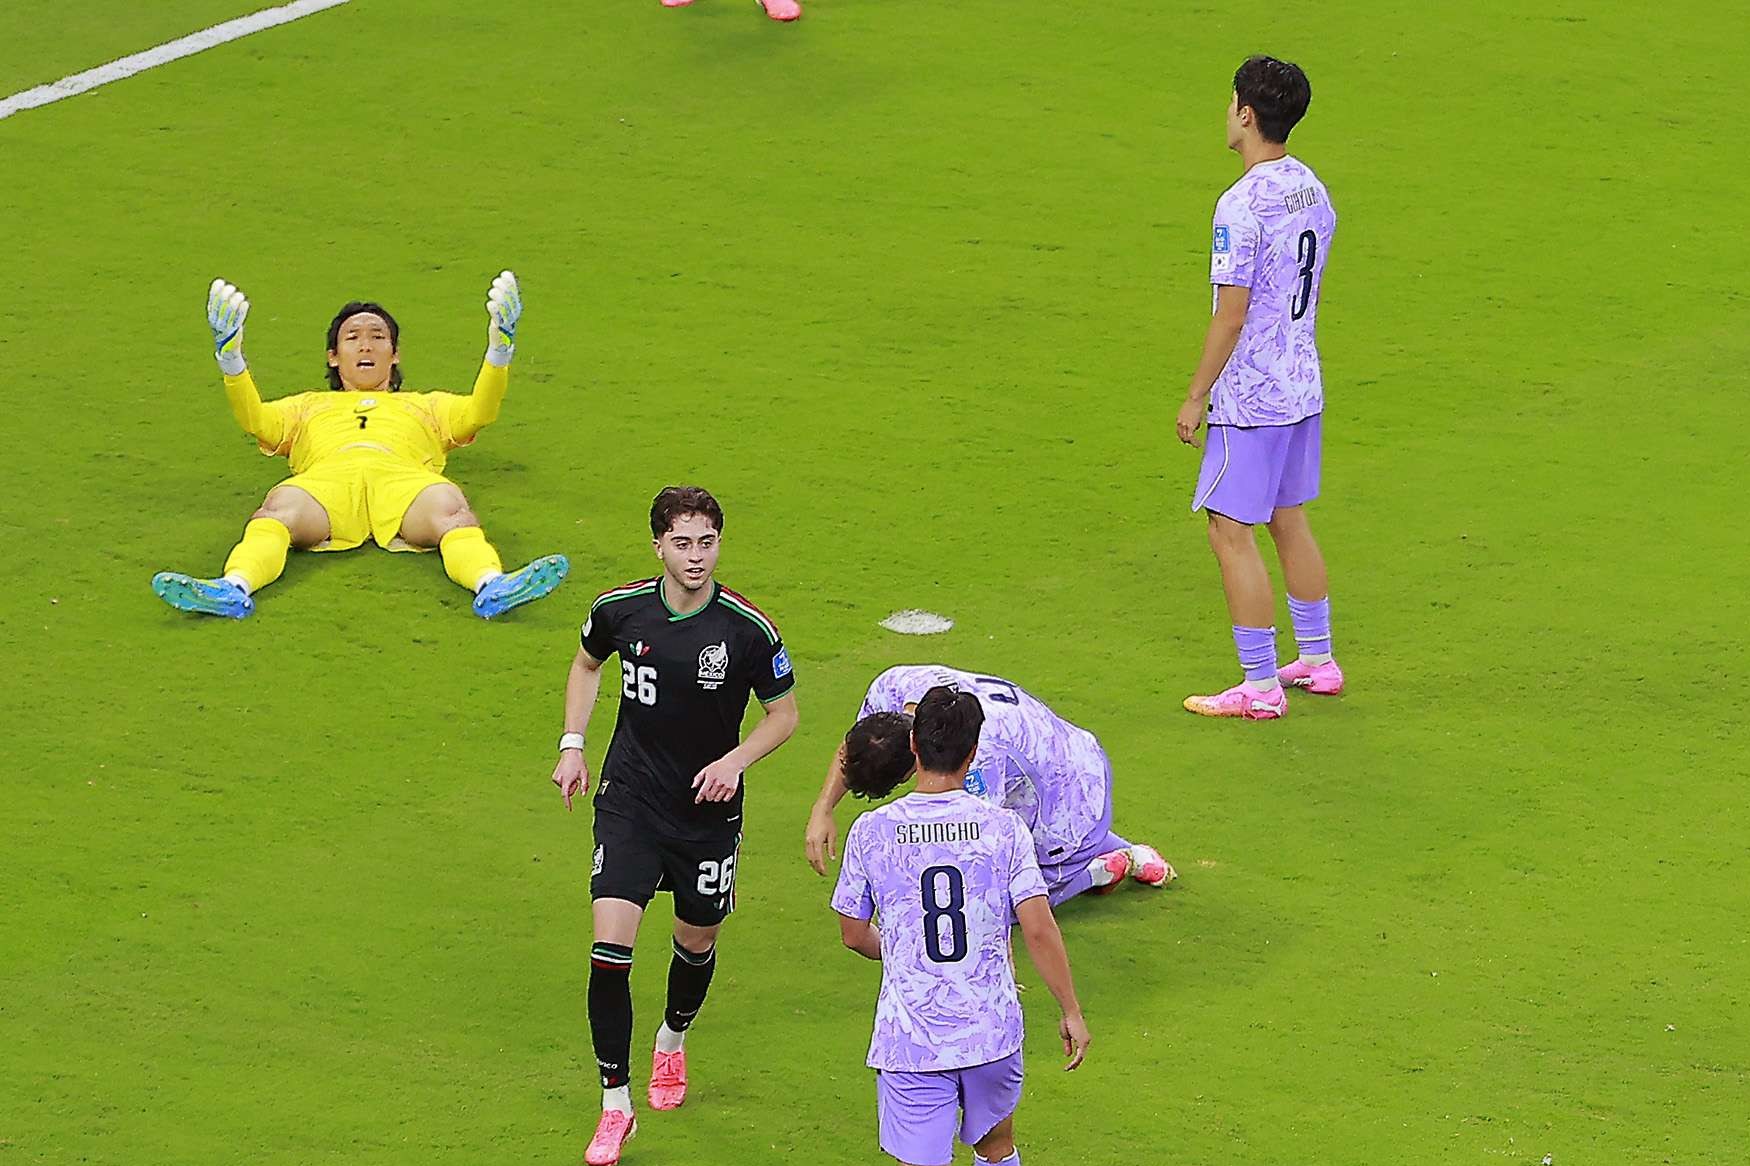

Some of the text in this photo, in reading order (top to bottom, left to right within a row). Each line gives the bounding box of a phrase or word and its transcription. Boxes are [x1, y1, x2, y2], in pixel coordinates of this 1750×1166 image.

[1290, 229, 1317, 322] 3
[622, 660, 657, 706] 26
[896, 821, 980, 844] SEUNGHO
[697, 855, 734, 896] 26
[920, 865, 969, 963] 8
